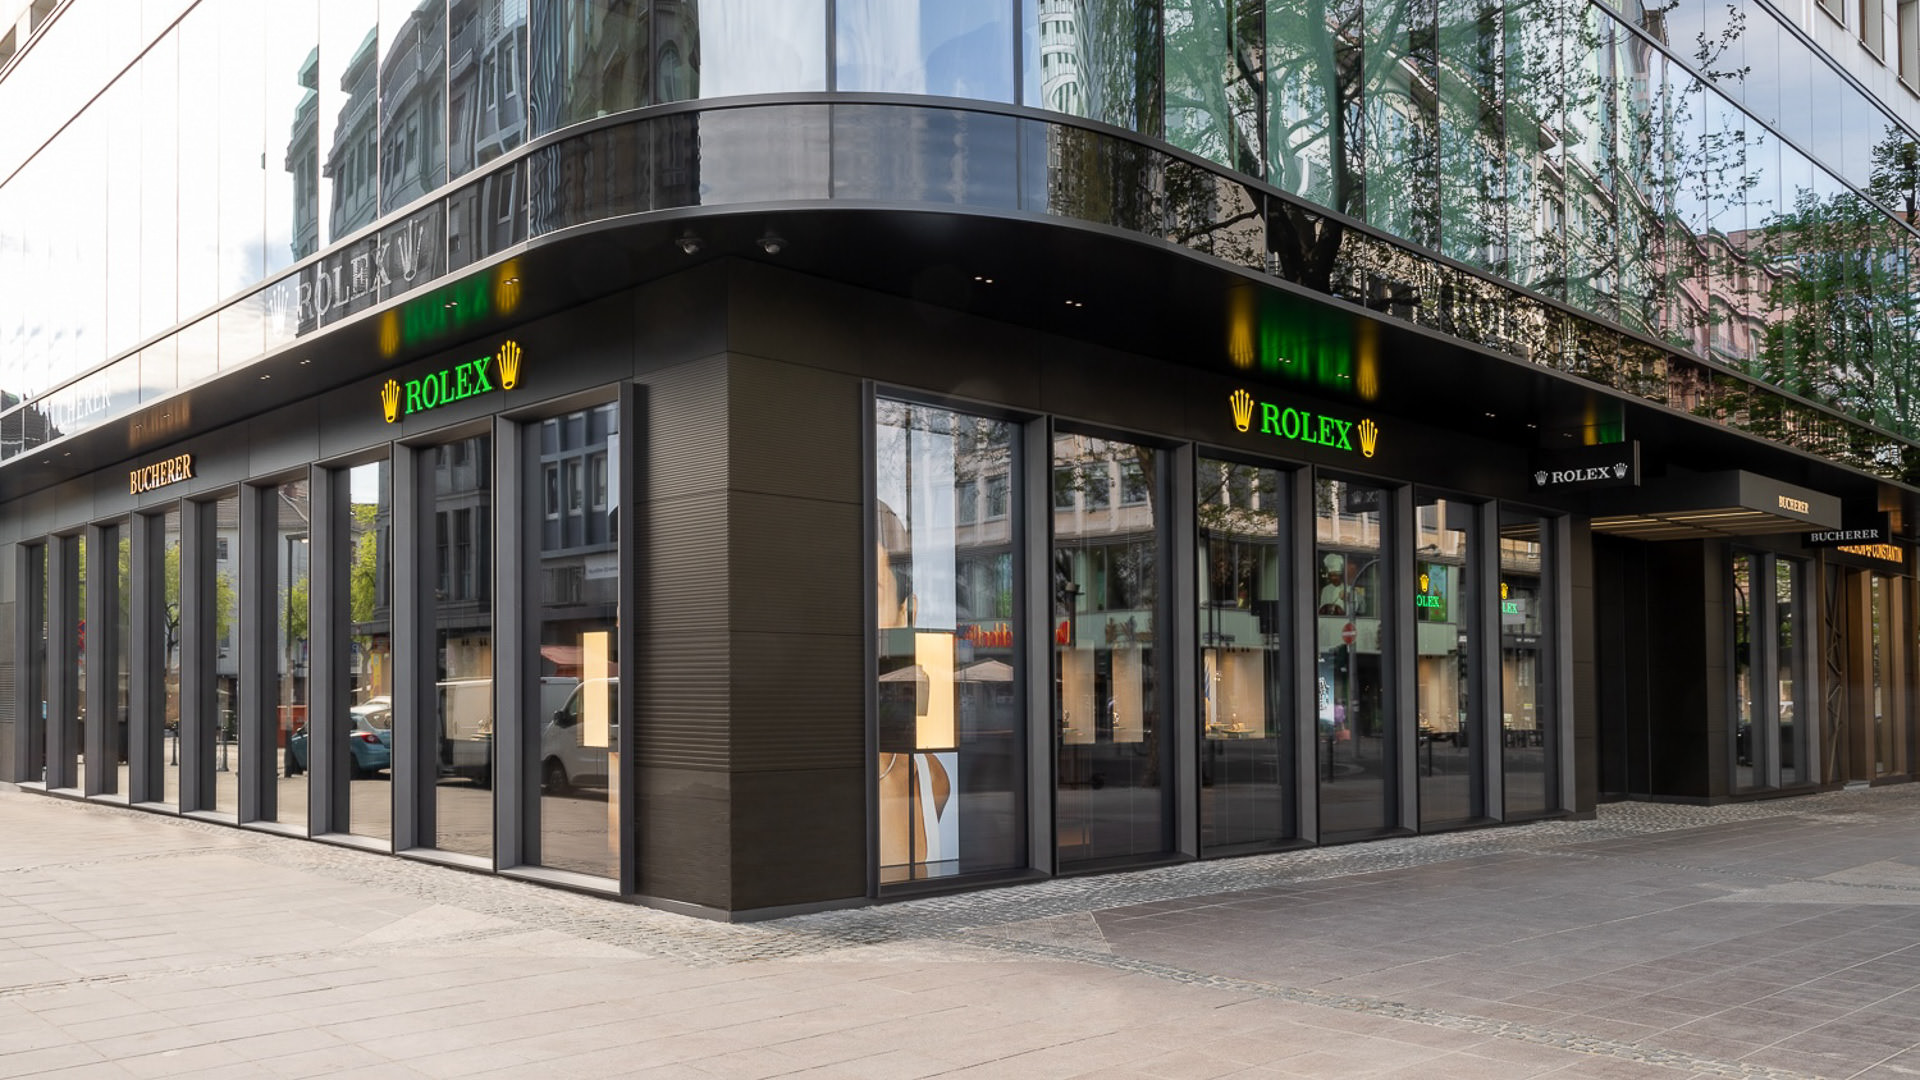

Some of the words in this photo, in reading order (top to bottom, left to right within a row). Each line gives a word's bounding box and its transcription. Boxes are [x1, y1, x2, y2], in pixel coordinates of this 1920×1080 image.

[295, 242, 392, 324] ROLEX
[405, 356, 492, 415] ROLEX
[45, 379, 112, 429] UCHERER
[1260, 402, 1353, 451] ROLEX
[130, 453, 192, 495] BUCHERER
[1551, 466, 1611, 484] ROLEX
[1778, 495, 1809, 514] BUCHERER
[1811, 529, 1879, 542] BUCHERER
[1416, 594, 1440, 608] OLEX
[1502, 601, 1519, 614] LEX
